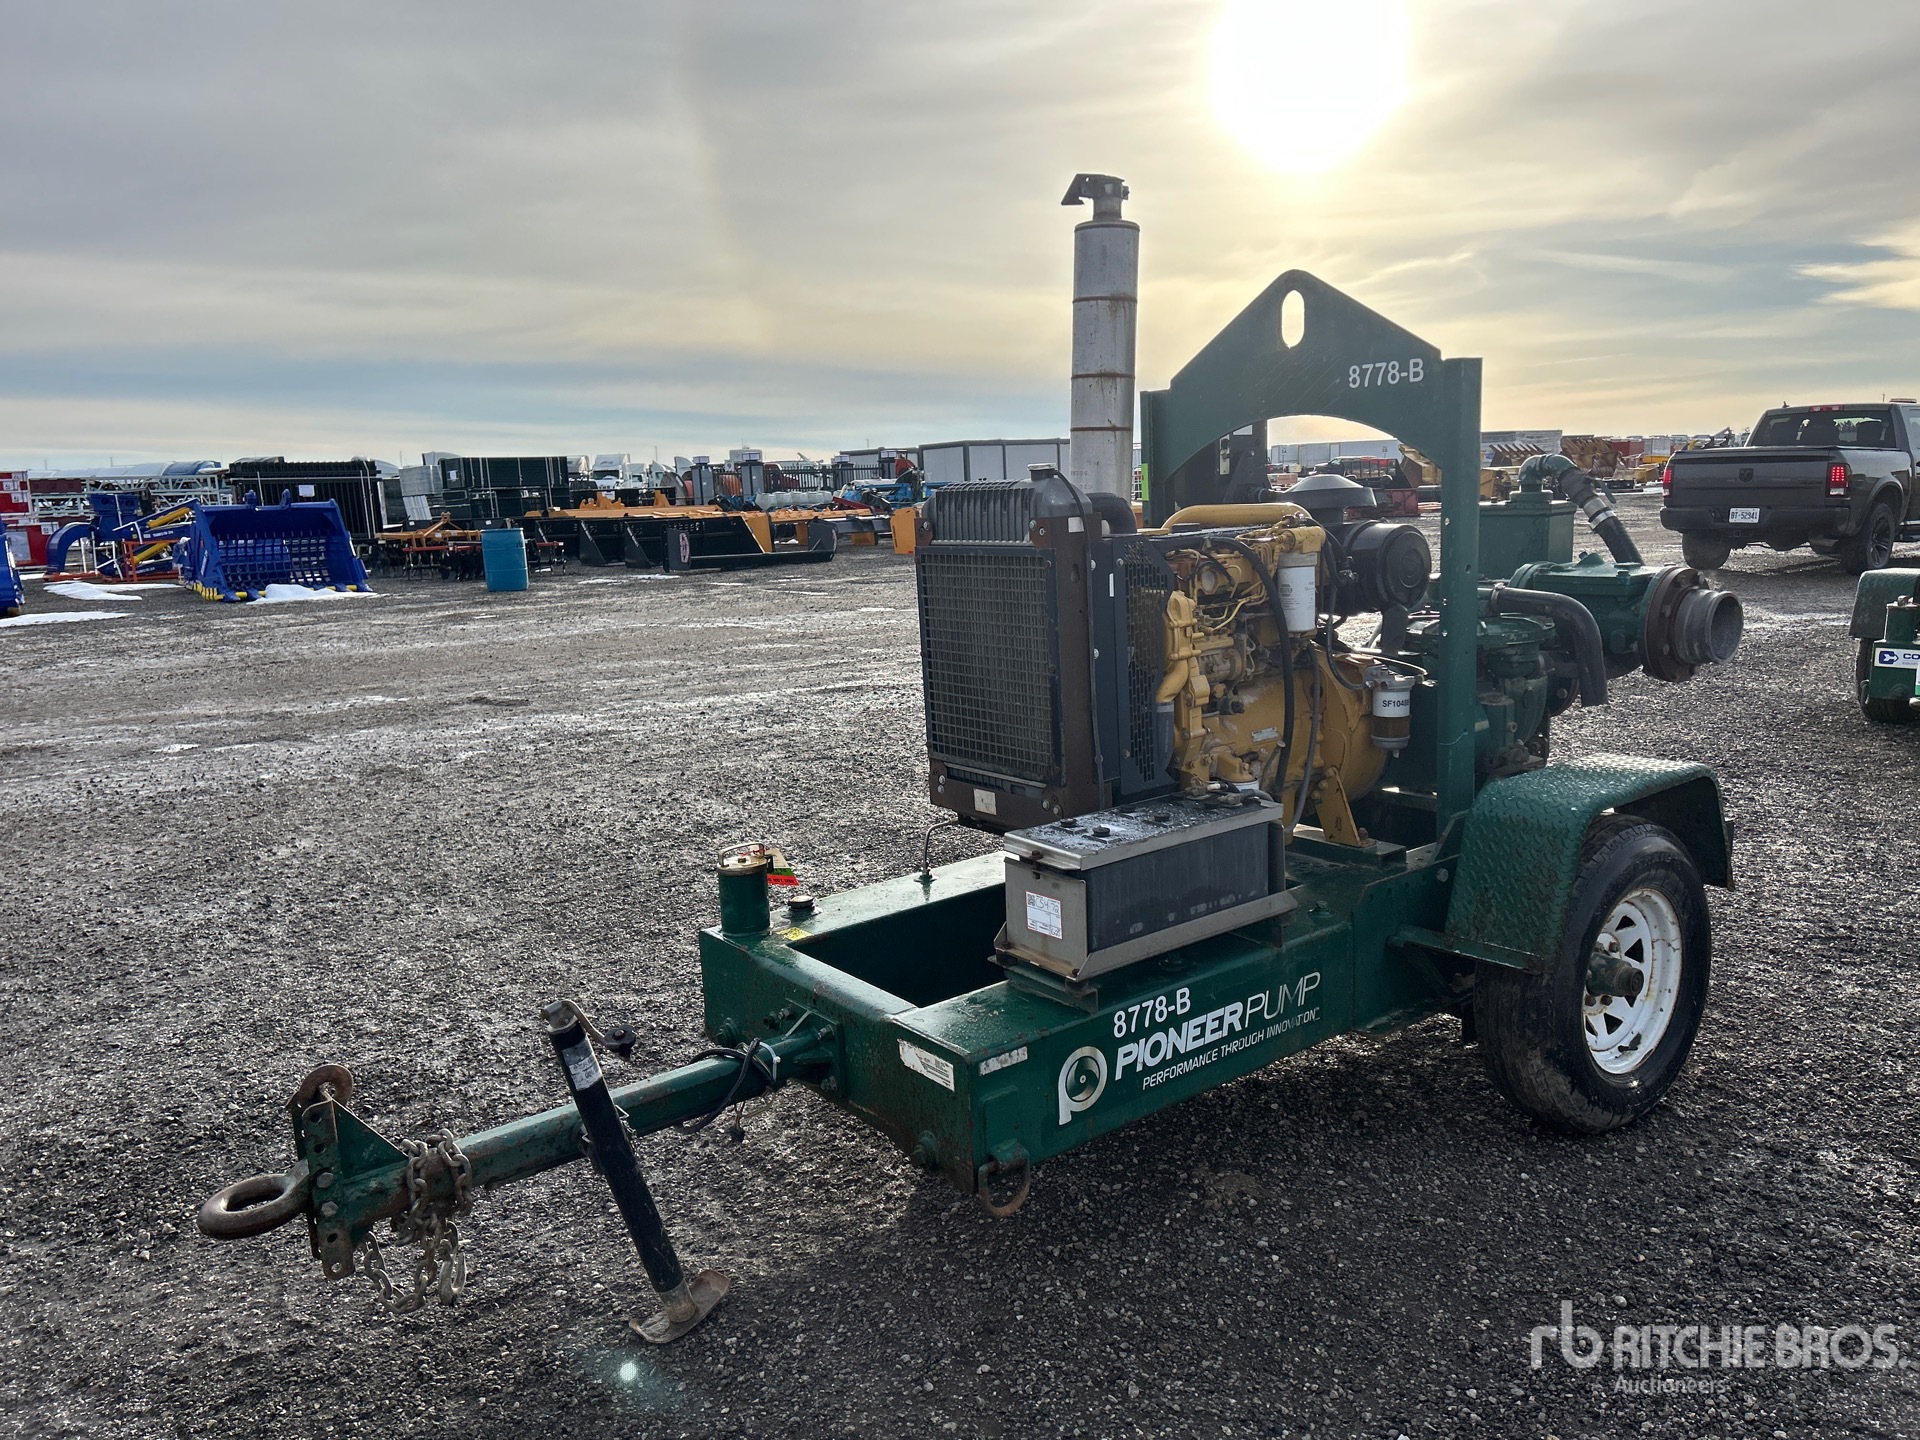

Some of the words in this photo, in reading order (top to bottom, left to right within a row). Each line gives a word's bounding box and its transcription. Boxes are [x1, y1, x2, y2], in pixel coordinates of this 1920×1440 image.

[1349, 358, 1424, 389] 8778-B
[1113, 987, 1191, 1038] 8778-B
[1142, 1048, 1218, 1091] PERFORMANCE
[1221, 1029, 1264, 1058] THROUGH
